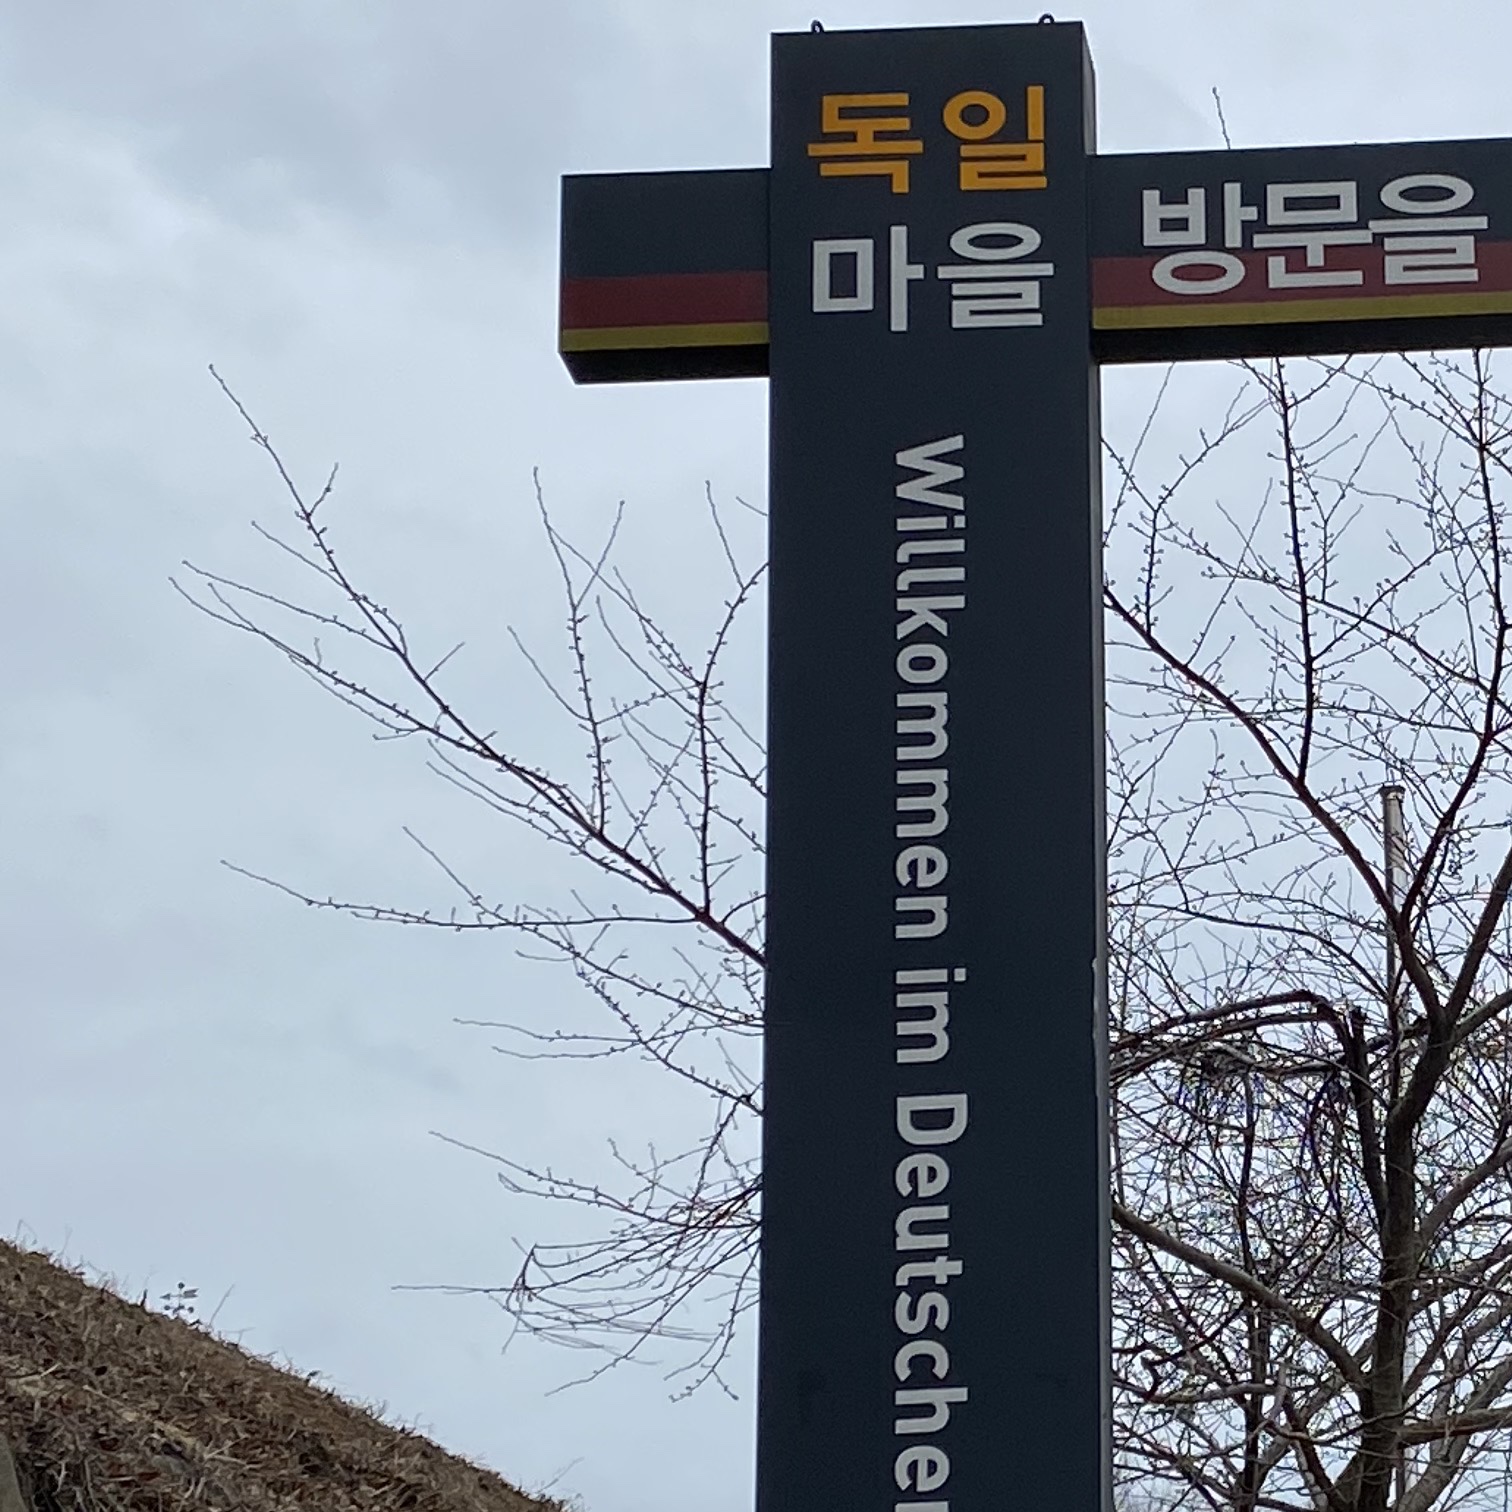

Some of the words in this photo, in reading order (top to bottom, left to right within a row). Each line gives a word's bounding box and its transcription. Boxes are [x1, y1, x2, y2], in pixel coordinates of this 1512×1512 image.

[807, 85, 1049, 194] 독일
[812, 222, 1055, 332] 마을
[1142, 173, 1490, 296] 방문을
[894, 434, 966, 939] Willkommen
[894, 968, 968, 1064] im
